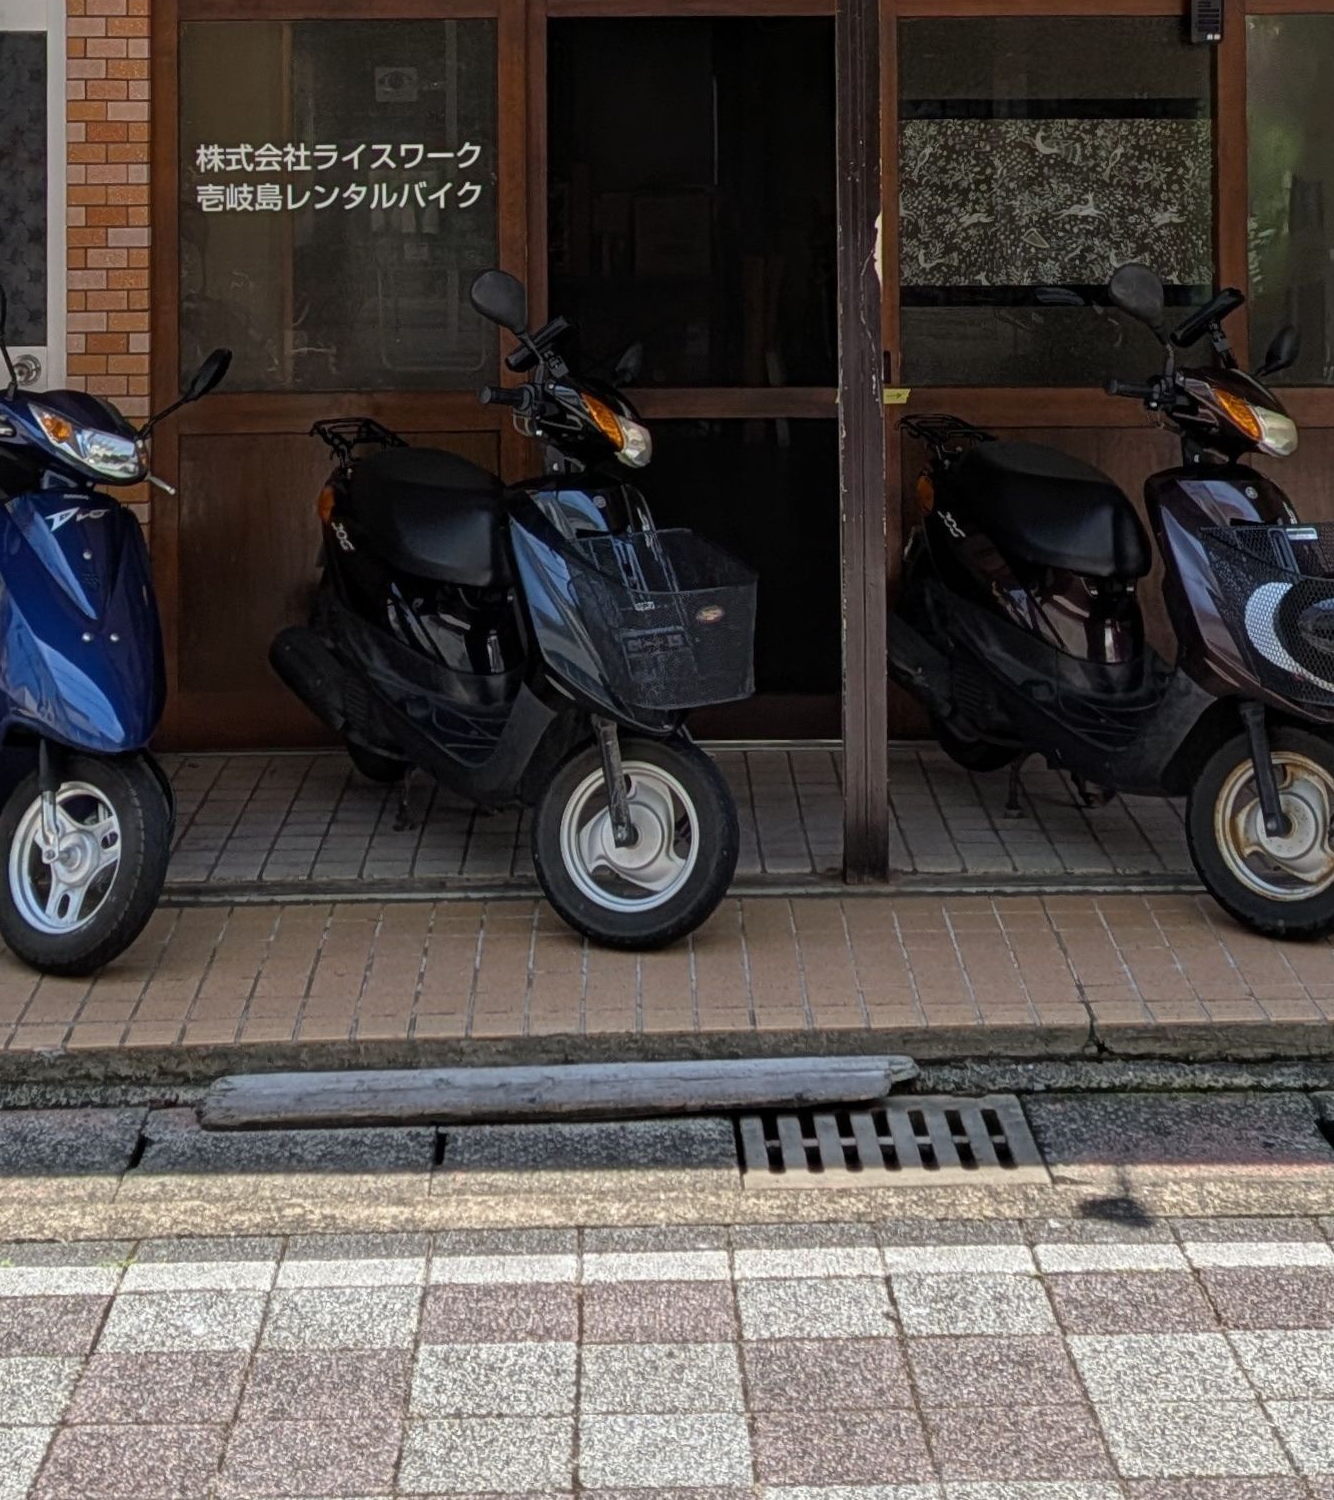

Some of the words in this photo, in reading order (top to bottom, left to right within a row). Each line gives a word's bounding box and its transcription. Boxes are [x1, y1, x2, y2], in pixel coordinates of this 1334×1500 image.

[195, 142, 482, 173] 株式会社ライスワーク
[195, 180, 482, 213] 壱岐島レンタルバイク
